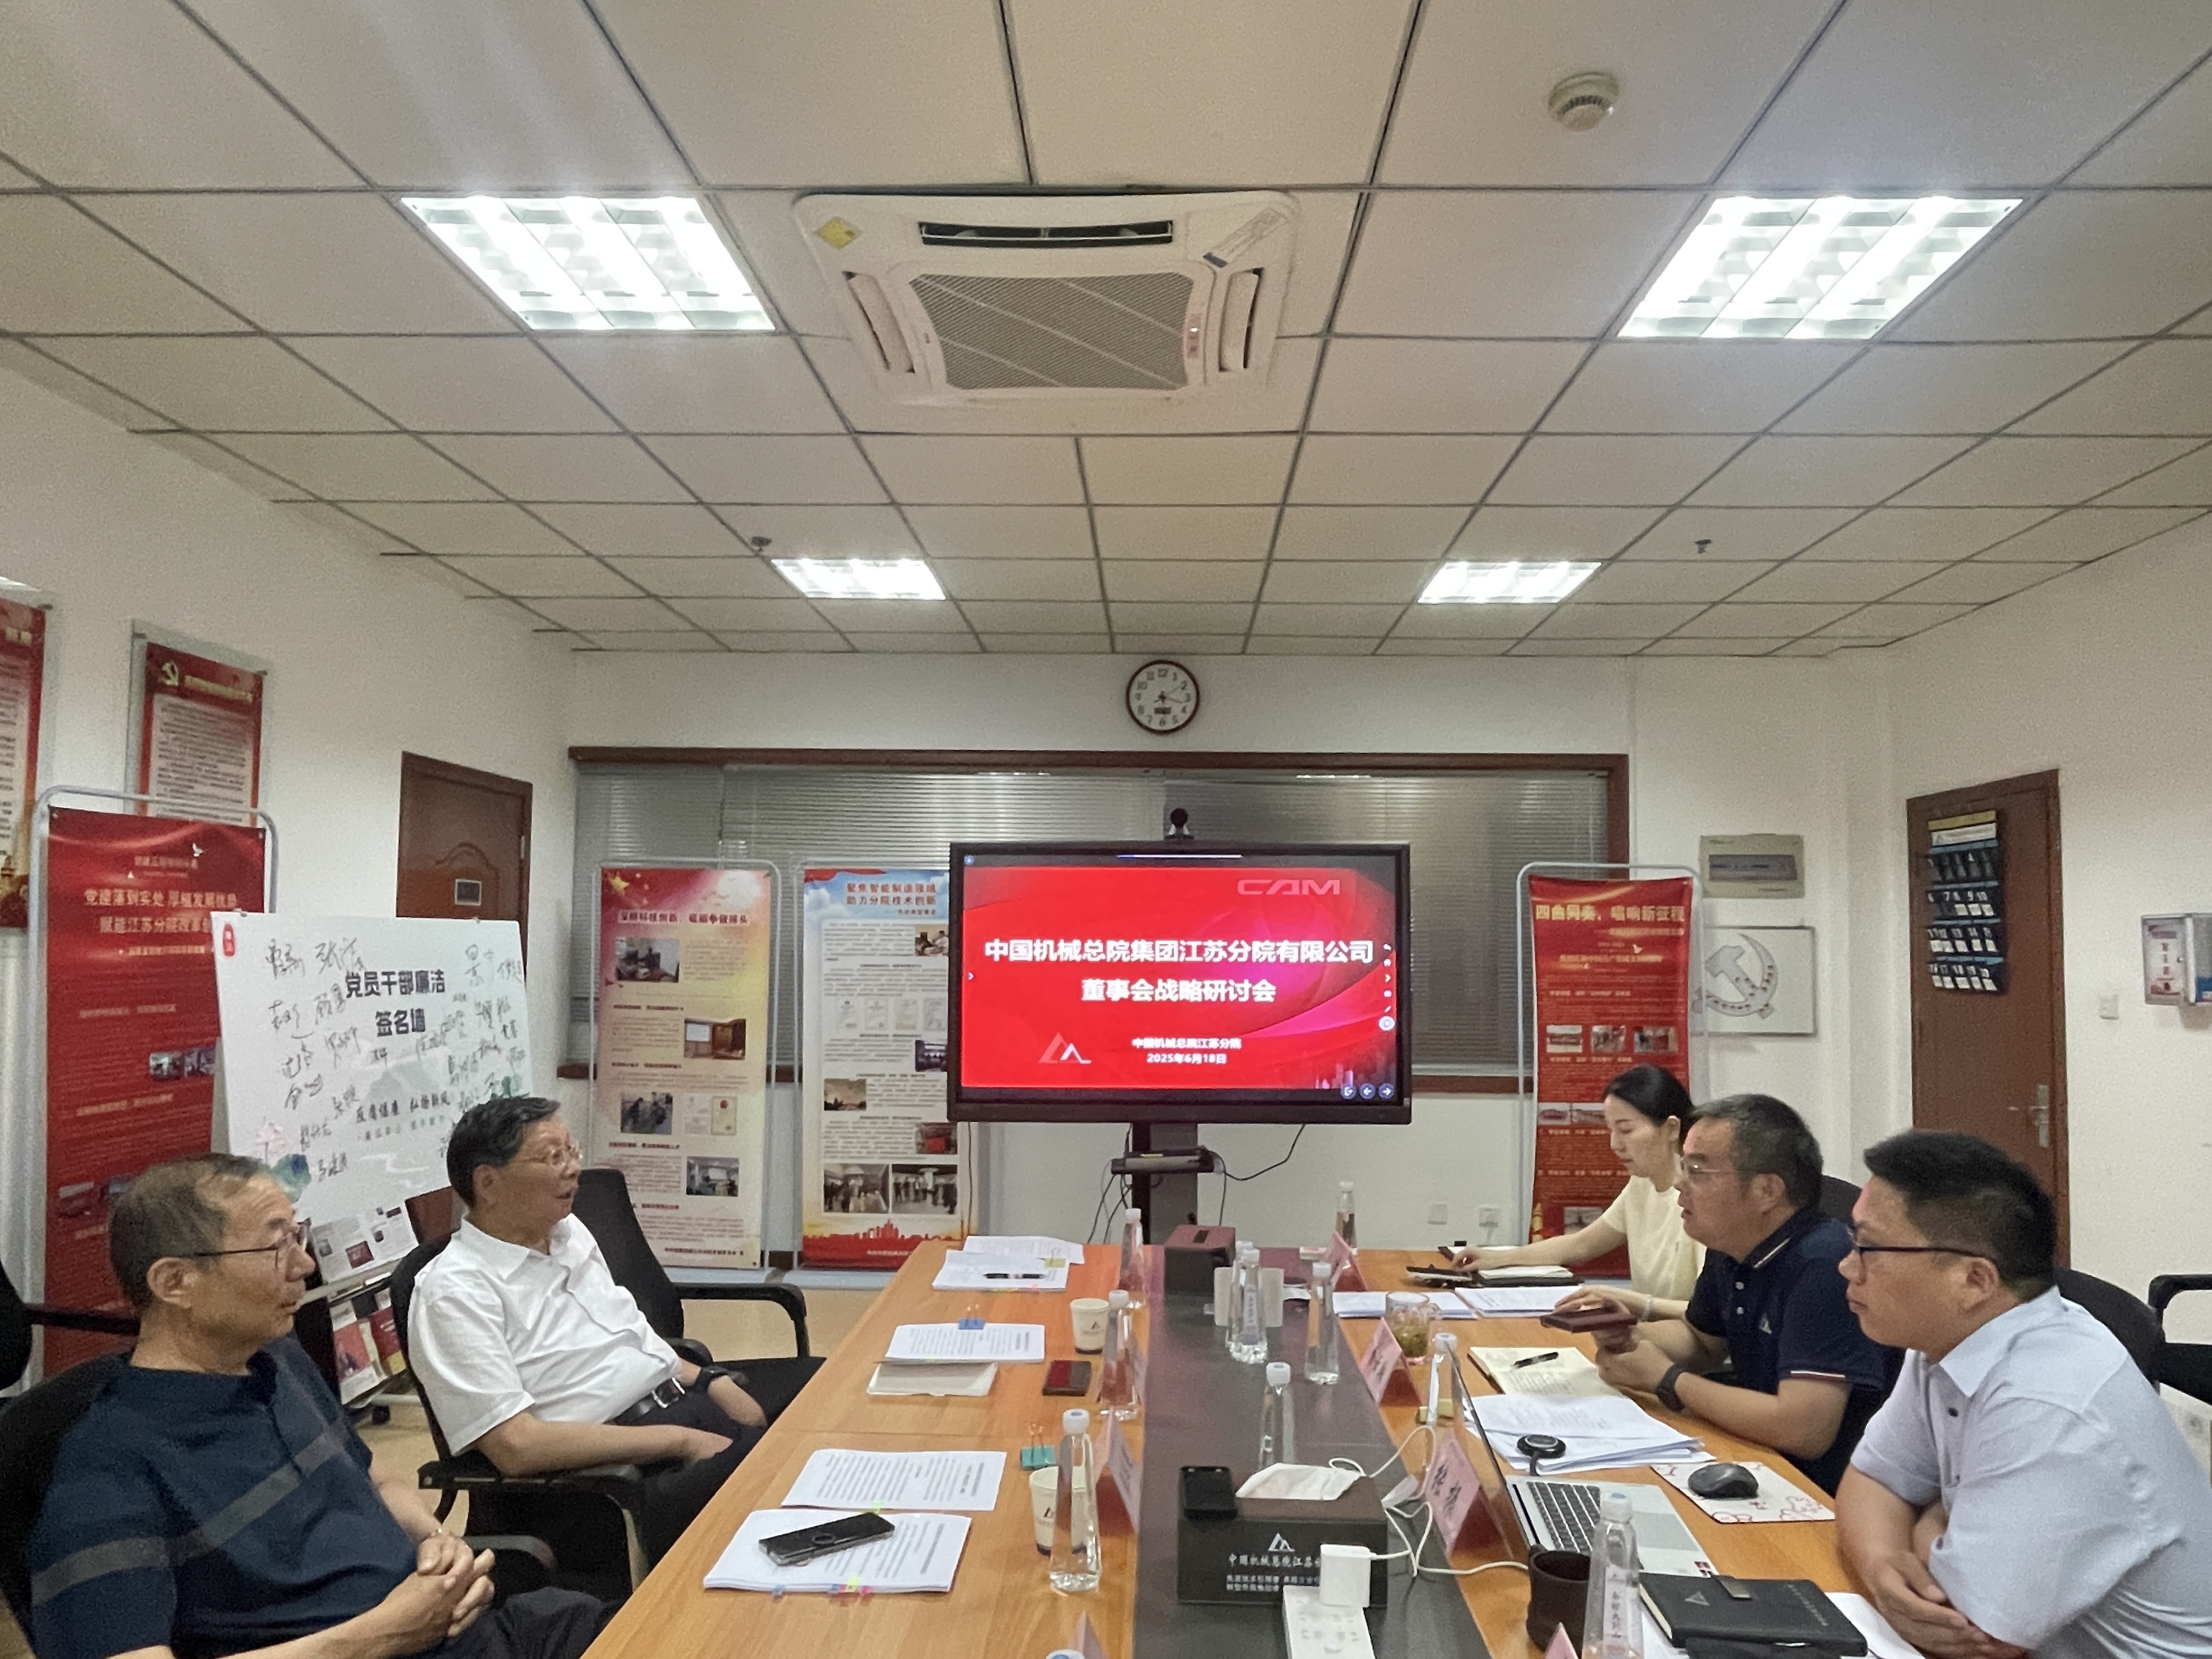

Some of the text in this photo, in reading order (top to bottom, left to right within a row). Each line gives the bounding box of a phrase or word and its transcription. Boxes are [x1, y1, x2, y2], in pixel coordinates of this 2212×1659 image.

[1158, 668, 1168, 678] 12
[1181, 680, 1188, 690] 2
[1237, 879, 1341, 895] CAM
[984, 939, 1374, 963] 中国机械总院集团江苏分院有限公司
[346, 969, 445, 999] 党员干部廉洁
[1081, 978, 1277, 1003] 董事会战略研讨会
[375, 1008, 426, 1037] 签名墙
[1131, 1037, 1242, 1049] 中国机械总院江苏分院
[1146, 1052, 1227, 1064] 2025年6月18日
